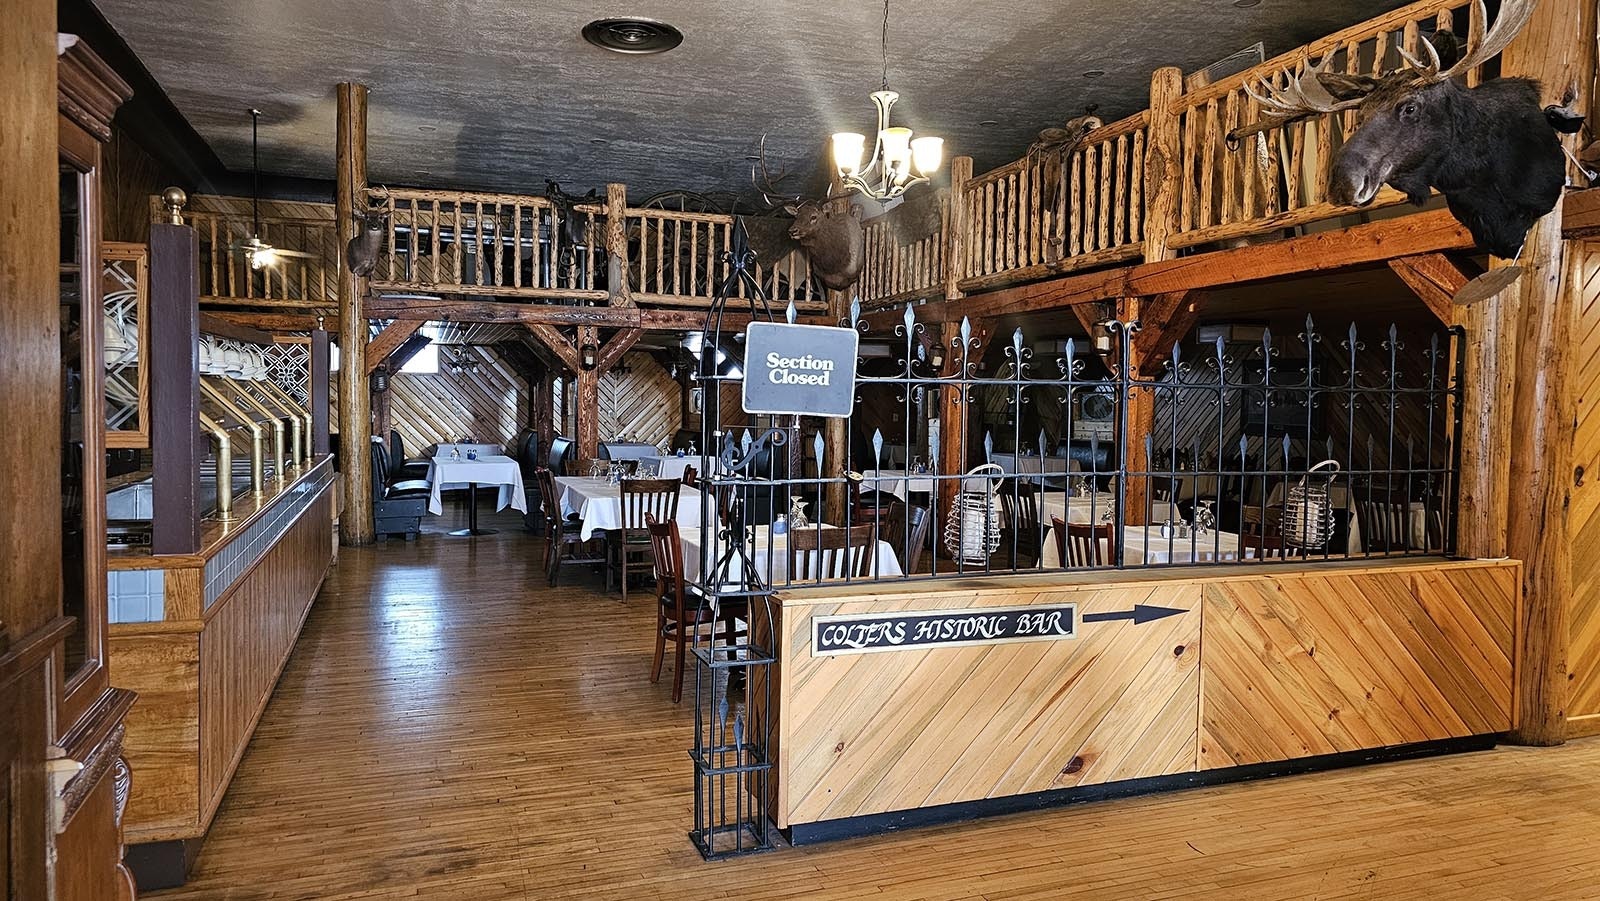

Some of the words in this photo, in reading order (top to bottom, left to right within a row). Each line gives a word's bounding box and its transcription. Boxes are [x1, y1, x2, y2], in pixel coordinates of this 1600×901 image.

[766, 352, 834, 370] Section
[768, 369, 830, 386] Closed
[821, 621, 907, 648] COLTERS
[912, 615, 1008, 641] HISTORIC
[1014, 611, 1071, 635] BAR
